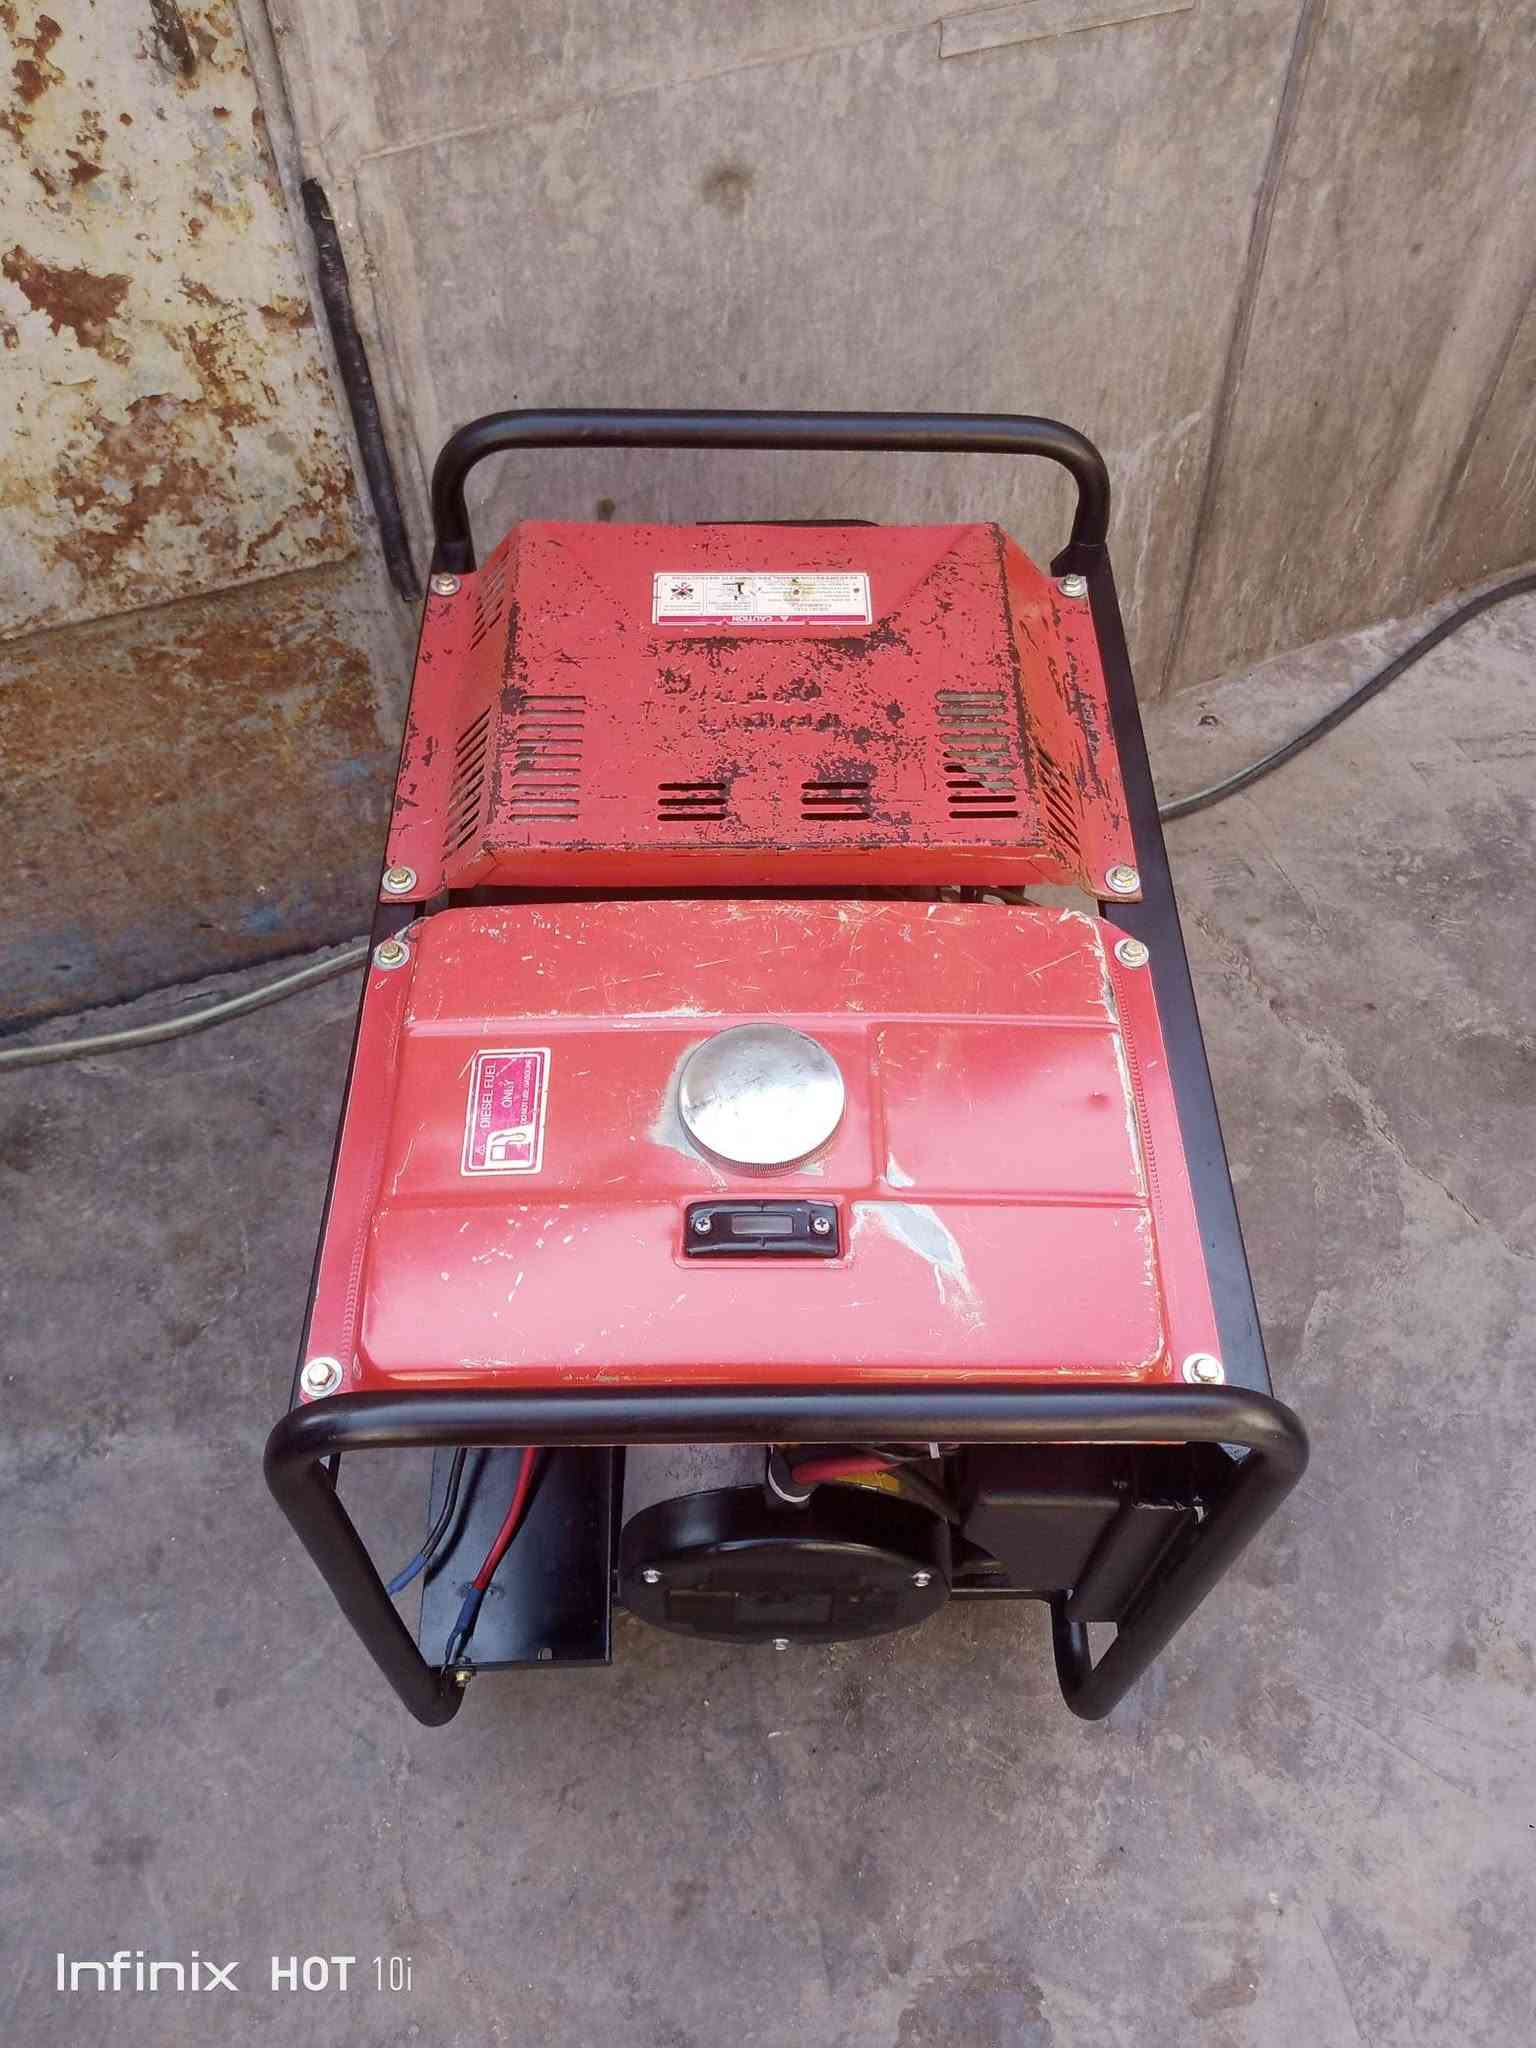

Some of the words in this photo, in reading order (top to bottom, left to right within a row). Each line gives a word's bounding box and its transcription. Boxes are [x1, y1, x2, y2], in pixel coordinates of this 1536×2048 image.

[484, 1063, 497, 1089] FUEL
[502, 1079, 514, 1108] ONLY
[480, 1090, 494, 1128] DIESEL
